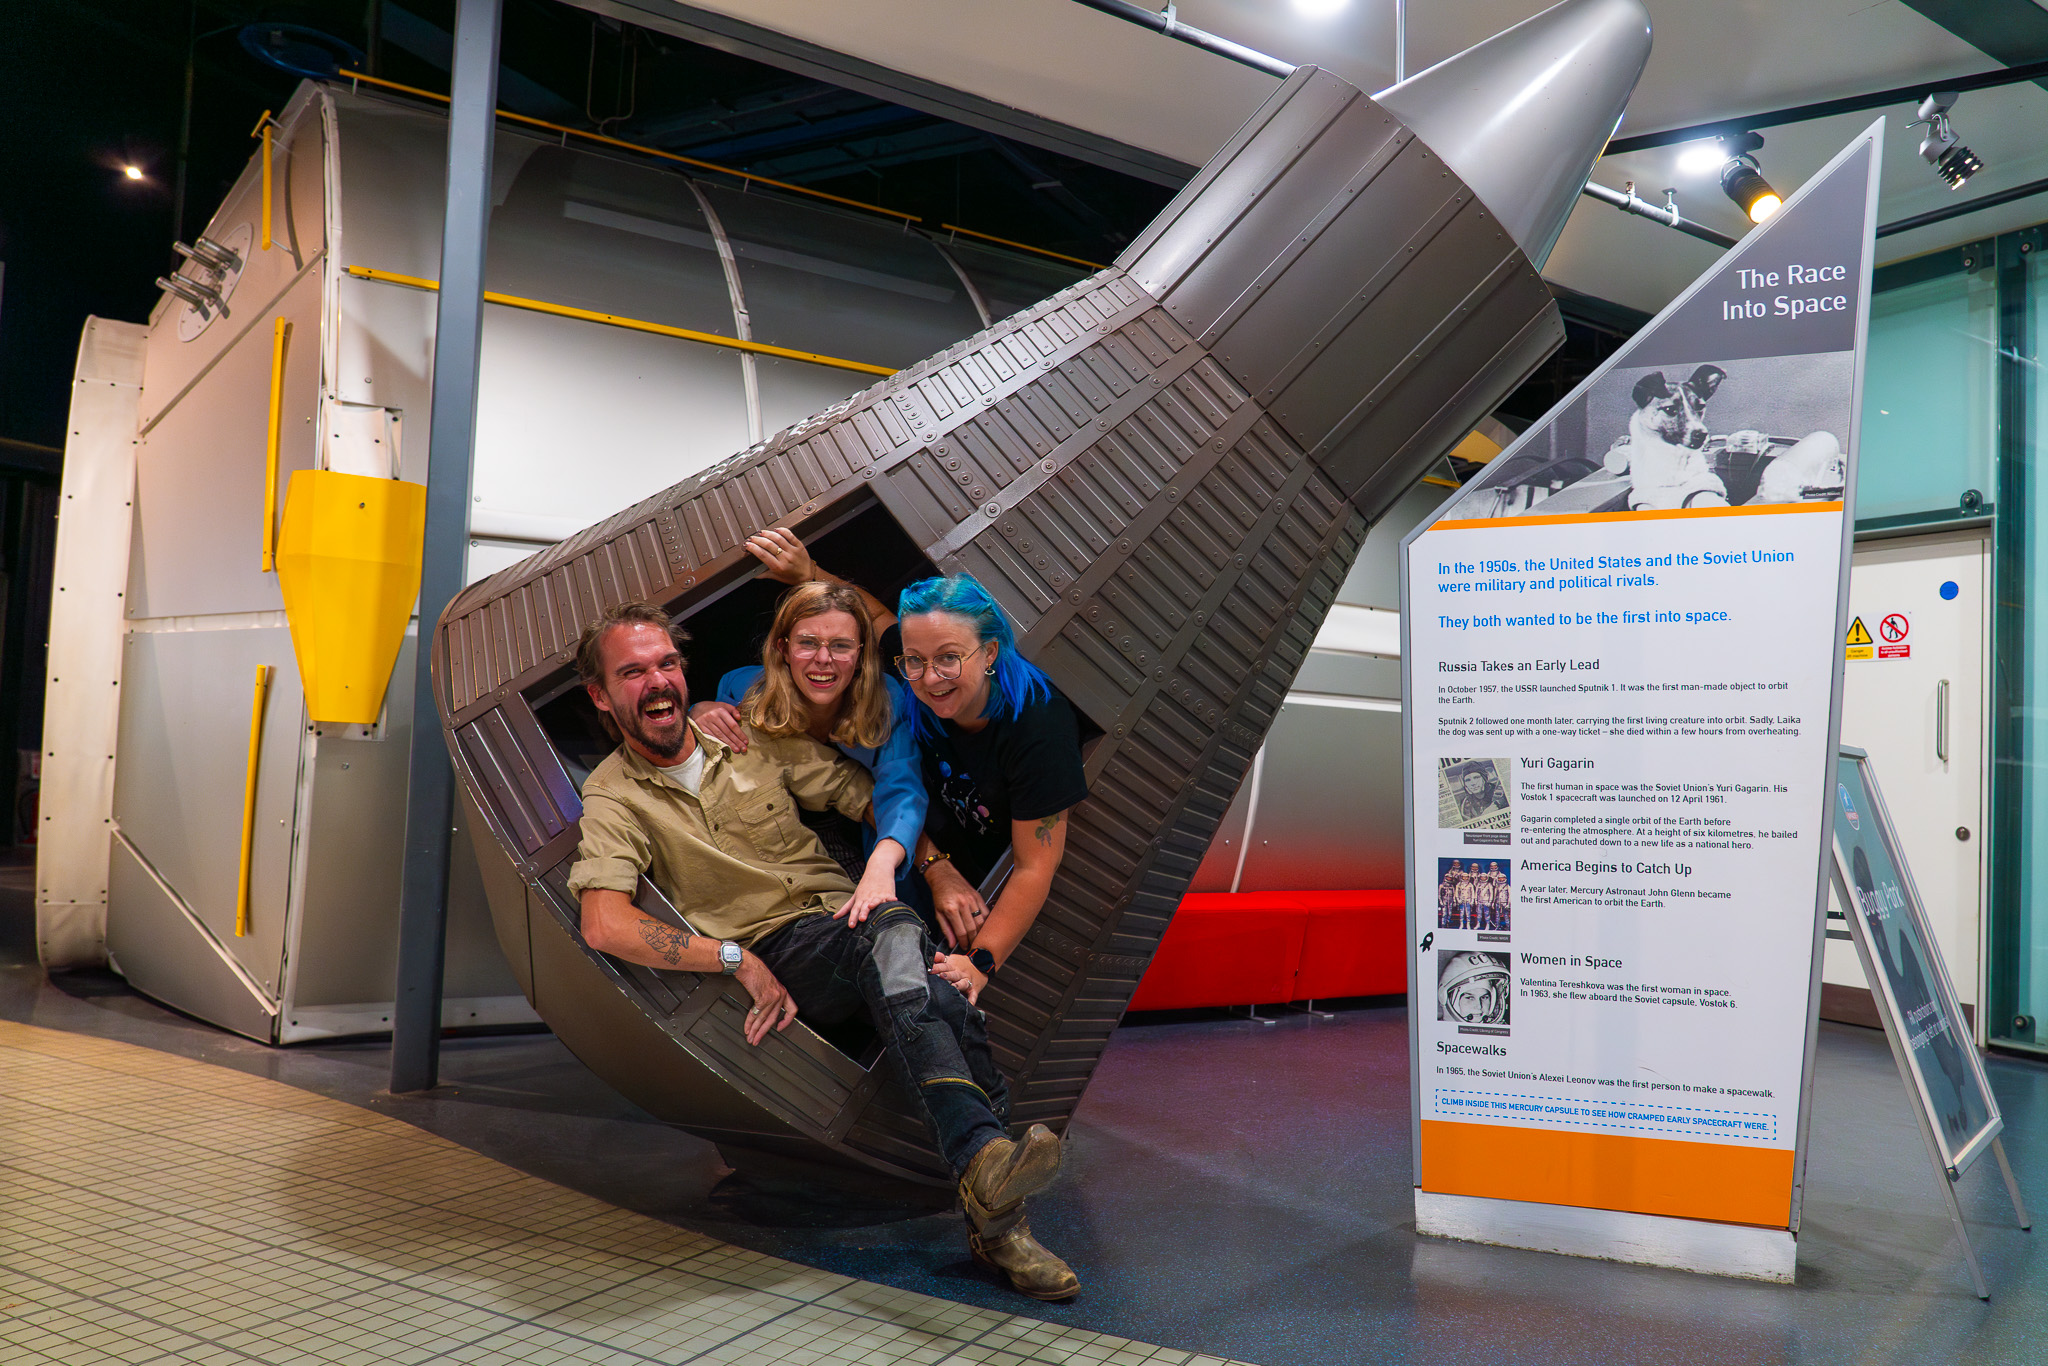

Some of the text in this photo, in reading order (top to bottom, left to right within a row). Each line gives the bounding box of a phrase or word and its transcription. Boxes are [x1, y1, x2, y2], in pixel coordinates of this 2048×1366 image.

[1736, 265, 1846, 289] The Race
[1723, 296, 1847, 321] Into Space
[1439, 550, 1794, 575] In the 1950s, the United States and the Soviet Union
[1438, 574, 1659, 594] were military and political rivals.
[1438, 610, 1732, 631] They both wanted to be the first into space.
[1439, 659, 1600, 673] Russia Takes an Early Lead
[1438, 718, 1468, 727] Sputnik
[1469, 717, 1474, 725] 2
[1476, 717, 1509, 725] followed
[1527, 717, 1552, 725] month
[1576, 717, 1610, 727] carrying
[1612, 717, 1625, 725] the
[1627, 717, 1644, 725] first
[1646, 717, 1668, 726] living
[1707, 716, 1723, 724] into
[1725, 716, 1747, 724] orbit.
[1777, 716, 1801, 724] Laika
[1520, 757, 1594, 771] Yuri Gagarin
[1521, 782, 1536, 790] The
[1537, 782, 1553, 790] first
[1555, 783, 1584, 791] human
[1586, 783, 1593, 791] in
[1640, 783, 1654, 792] the
[1655, 784, 1681, 792] Soviet
[1716, 784, 1733, 792] Yuri
[1735, 784, 1771, 794] Gagarin.
[1774, 785, 1788, 793] His
[1521, 793, 1547, 801] Vostok
[1556, 794, 1597, 803] spacecraft
[1618, 794, 1656, 803] launched
[1671, 795, 1681, 803] 12
[1682, 795, 1703, 805] April
[1706, 795, 1727, 803] 1961.
[1521, 815, 1552, 825] Gagarin
[1554, 816, 1596, 825] completed
[1605, 816, 1630, 826] single
[1632, 817, 1651, 825] orbit
[1653, 817, 1662, 825] of
[1663, 817, 1677, 825] the
[1679, 817, 1702, 825] Earth
[1704, 818, 1731, 826] before
[1520, 860, 1692, 878] America Begins to Catch Up
[1520, 895, 1534, 904] the
[1535, 896, 1551, 904] first
[1553, 896, 1593, 905] American
[1594, 898, 1603, 906] to
[1625, 899, 1639, 907] the
[1641, 899, 1666, 908] Earth.
[1528, 886, 1547, 894] year
[1570, 886, 1604, 897] Mercury
[1605, 887, 1646, 896] Astronaut
[1648, 888, 1669, 897] John
[1671, 889, 1695, 898] Glenn
[1698, 890, 1732, 899] became
[1856, 879, 1905, 920] Buggy Park
[1520, 953, 1622, 970] Women in Space
[1520, 978, 1557, 988] Valentina
[1559, 980, 1605, 990] Tereshkova
[1626, 984, 1640, 992] the
[1641, 984, 1658, 993] first
[1694, 987, 1702, 995] in
[1704, 989, 1732, 997] space.
[1521, 989, 1528, 997] In
[1553, 991, 1568, 999] she
[1570, 992, 1587, 1000] flew
[1589, 993, 1618, 1002] aboard
[1619, 994, 1633, 1003] the
[1635, 995, 1660, 1004] Soviet
[1699, 999, 1728, 1008] Vostok
[1730, 1000, 1738, 1009] 6.
[1437, 1041, 1507, 1056] Spacewalks
[1437, 1066, 1444, 1074] In
[1468, 1068, 1480, 1077] the
[1482, 1069, 1506, 1078] Soviet
[1539, 1073, 1564, 1083] Alexei
[1566, 1075, 1596, 1085] Leonov
[1617, 1079, 1630, 1087] the
[1632, 1080, 1649, 1089] first
[1651, 1083, 1680, 1091] person
[1683, 1084, 1691, 1092] to
[1693, 1085, 1717, 1094] make
[1727, 1089, 1775, 1098] spacewalk.
[1441, 1098, 1769, 1131] CLIMB INSIDE THIS MERCURY CAPSULE TO SEE HOW CRAMPED EARLY SPACECRAFT WERE.
